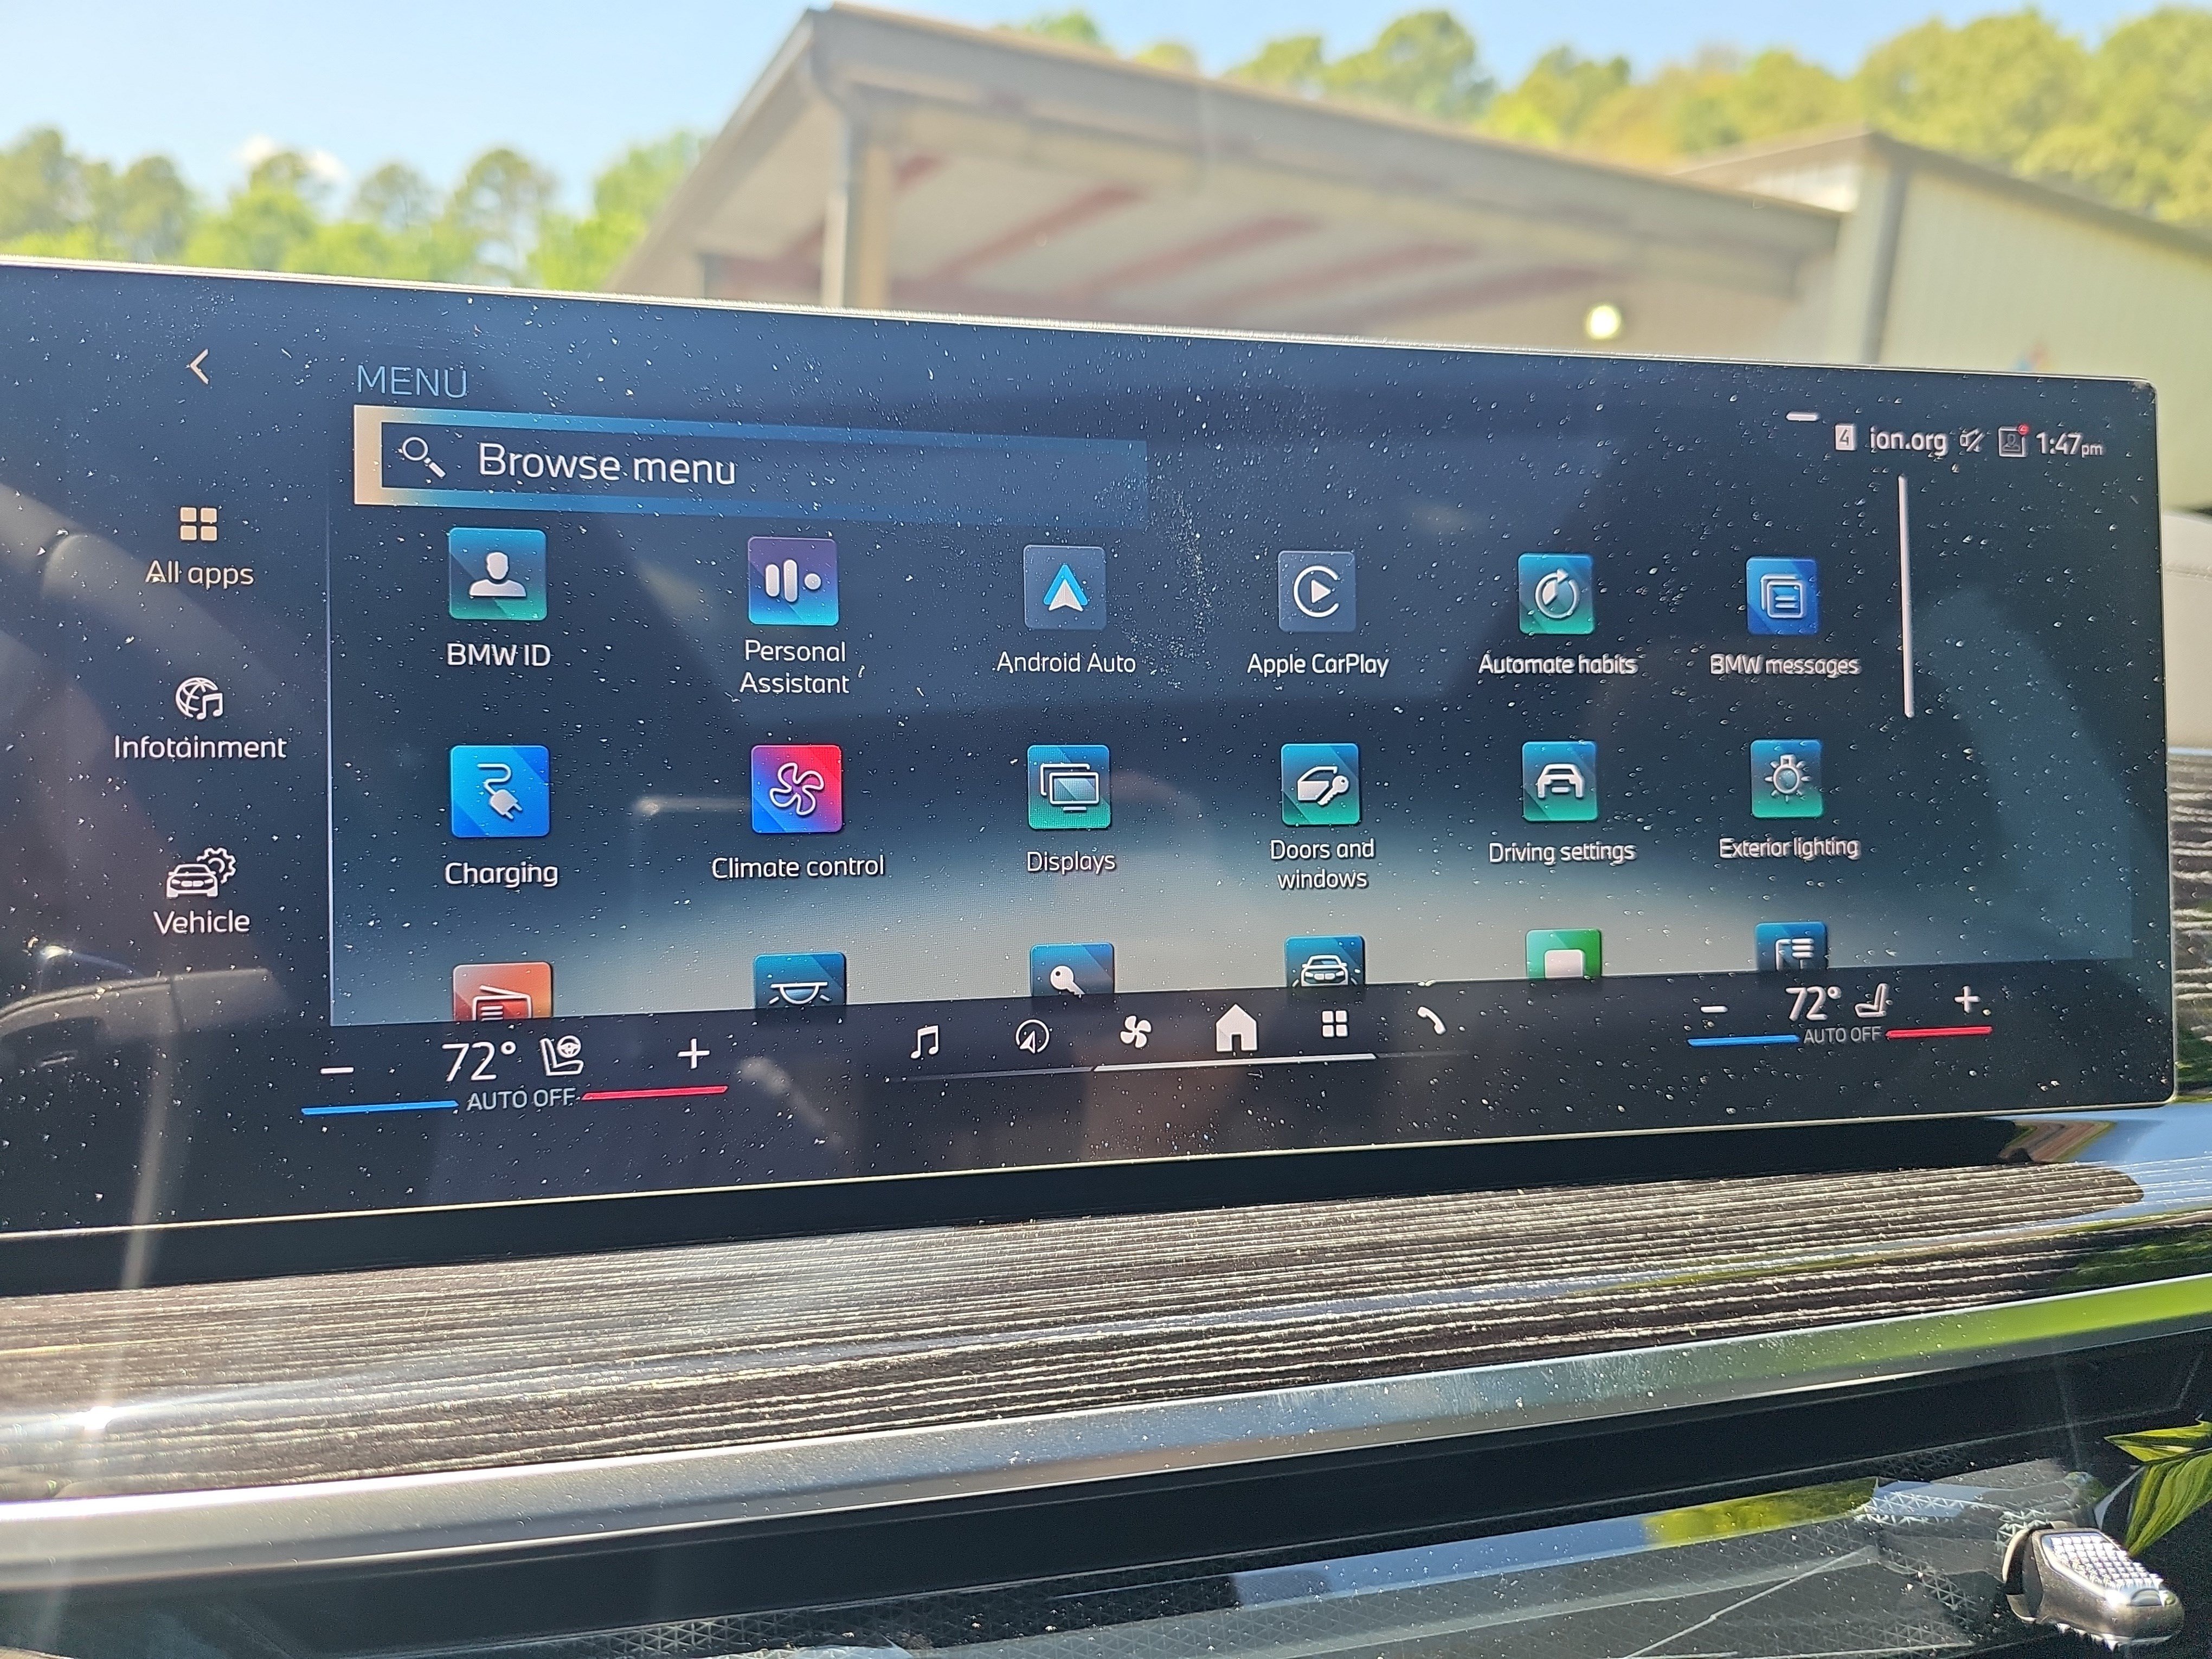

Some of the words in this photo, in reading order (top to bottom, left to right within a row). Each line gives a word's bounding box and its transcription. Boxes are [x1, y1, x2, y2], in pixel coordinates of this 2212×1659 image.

[357, 364, 468, 398] MENU
[1870, 426, 1950, 455] ion.org
[479, 442, 620, 480] Browse
[633, 456, 736, 485] menu
[145, 560, 179, 584] All
[188, 565, 254, 589] apps
[447, 644, 522, 666] BMW
[524, 645, 551, 667] ID
[744, 640, 846, 662] Personal
[997, 652, 1081, 674] Android
[1086, 653, 1136, 674] Auto
[1247, 654, 1306, 676] Apple
[1311, 654, 1390, 678] CarPlay
[1478, 654, 1573, 674] Automate
[1578, 654, 1638, 674] habits
[1711, 654, 1762, 674] BMW
[1765, 657, 1861, 677] messages
[740, 672, 850, 695] Assistant
[114, 735, 287, 759] Infotainment
[1271, 840, 1331, 860] Doors
[1337, 838, 1375, 858] and
[1489, 843, 1556, 864] Driving
[1560, 843, 1636, 862] settings
[1719, 839, 1791, 858] Exterior
[1793, 838, 1861, 860] lighting
[712, 858, 800, 879] Climate
[807, 855, 884, 876] control
[1027, 851, 1116, 874] Displays
[445, 863, 558, 888] Charging
[1277, 870, 1368, 890] windows
[154, 910, 250, 935] Vehicle
[1803, 1027, 1846, 1045] AUTO
[1850, 1026, 1881, 1041] OFF
[466, 1091, 528, 1111] AUTO
[533, 1088, 576, 1107] OFF
